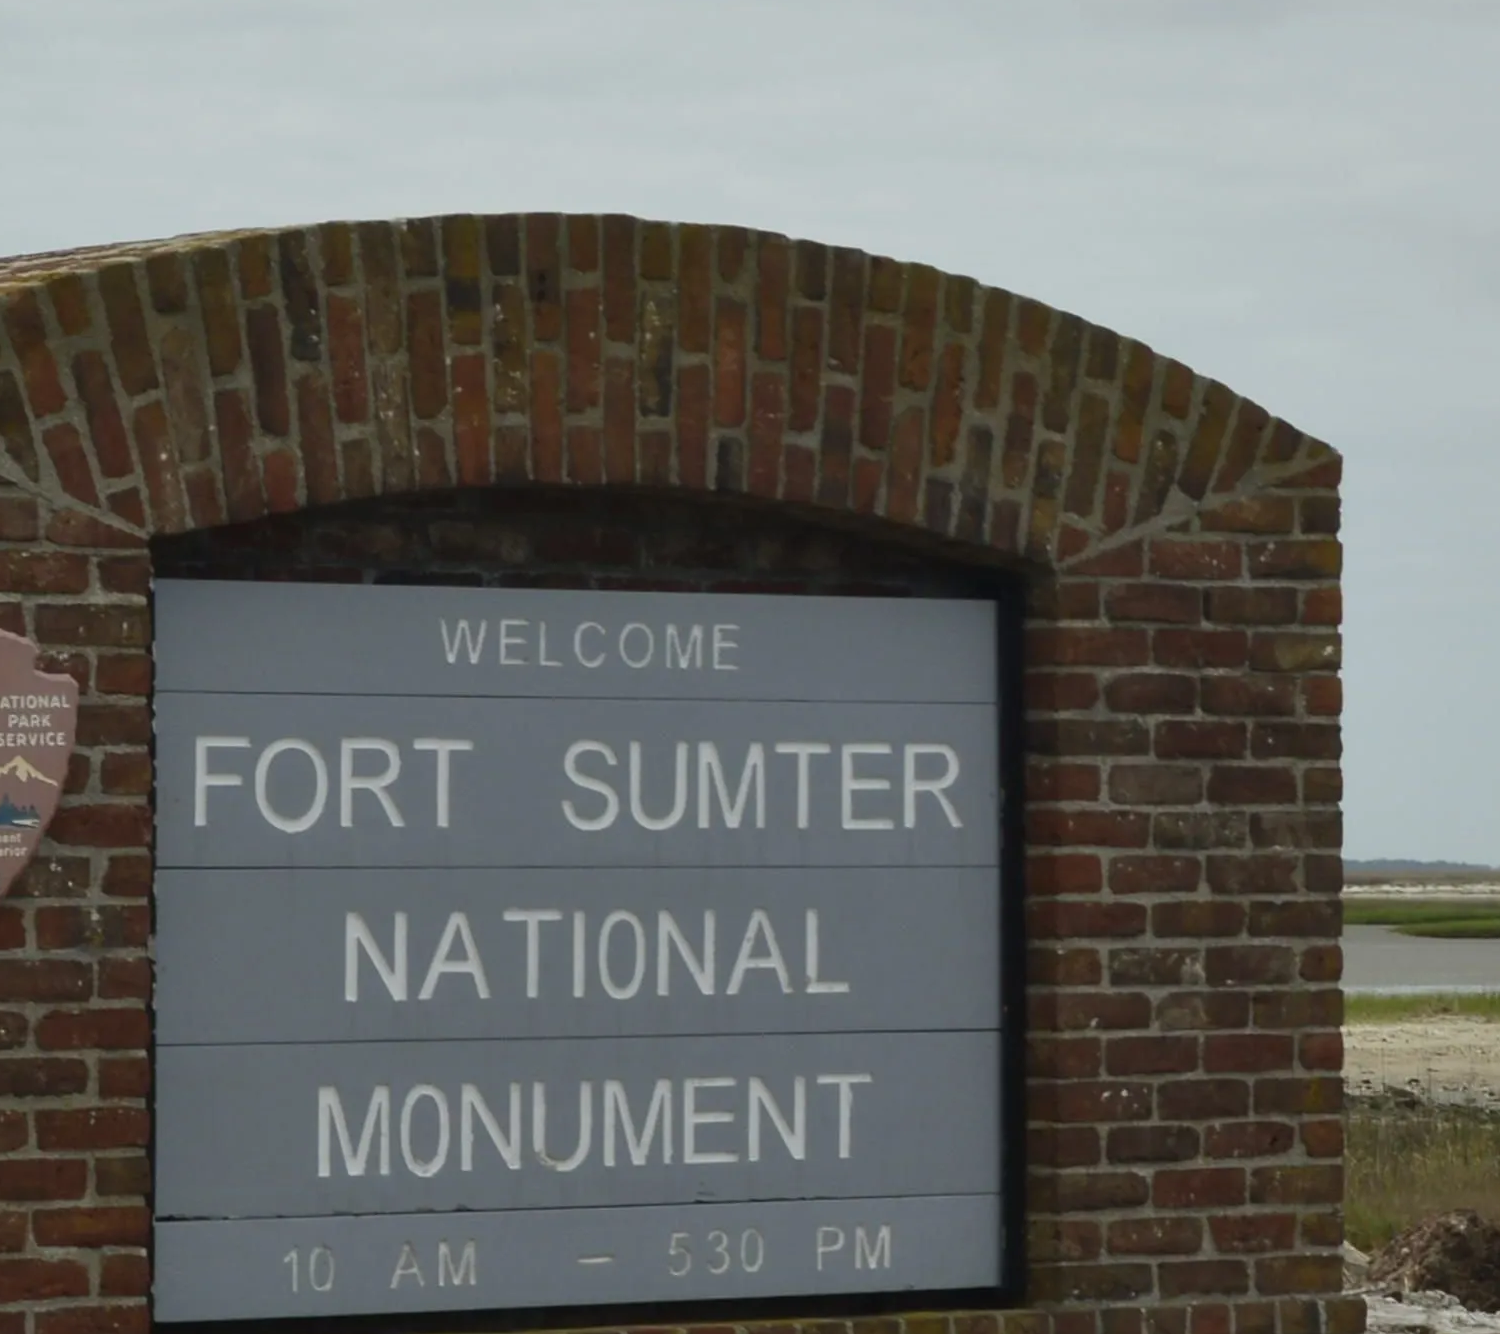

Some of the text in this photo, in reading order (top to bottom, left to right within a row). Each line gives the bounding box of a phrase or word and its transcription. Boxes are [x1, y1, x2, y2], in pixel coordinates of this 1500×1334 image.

[440, 617, 741, 672] WELCOME
[8, 714, 52, 728] PARK
[193, 735, 964, 835] FORT SUMTER
[343, 907, 852, 1003] NATIONAL
[316, 1072, 874, 1179] MONUMENT
[281, 1245, 336, 1294] 10
[388, 1239, 479, 1290] AM
[666, 1228, 766, 1279] 530
[815, 1224, 893, 1272] PM
